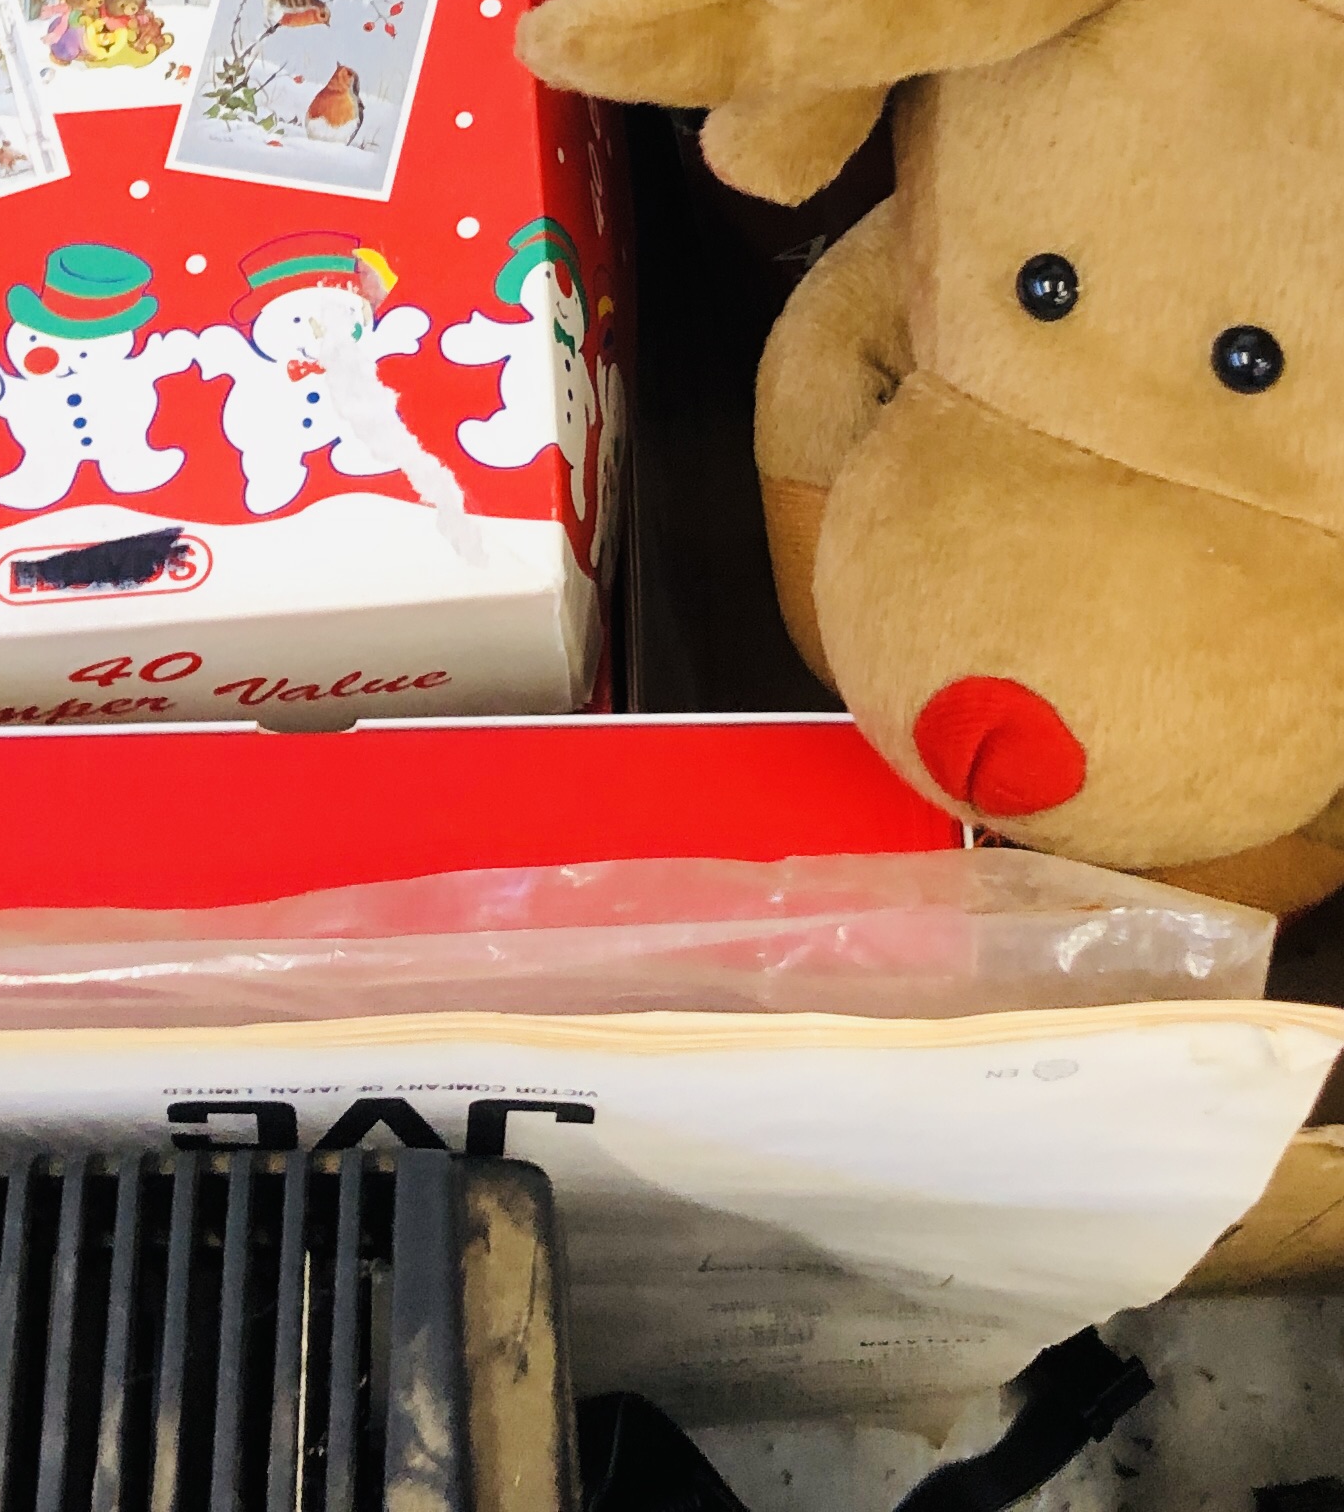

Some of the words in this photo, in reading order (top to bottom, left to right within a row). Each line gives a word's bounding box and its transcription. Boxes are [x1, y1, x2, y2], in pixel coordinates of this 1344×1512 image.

[67, 650, 204, 688] 40
[211, 669, 454, 708] Value
[162, 1084, 255, 1097] LIMITED
[361, 1083, 385, 1096] OF
[394, 1082, 508, 1096] COMPANY
[515, 1085, 598, 1099] VICTOR
[167, 1096, 596, 1158] JVC
